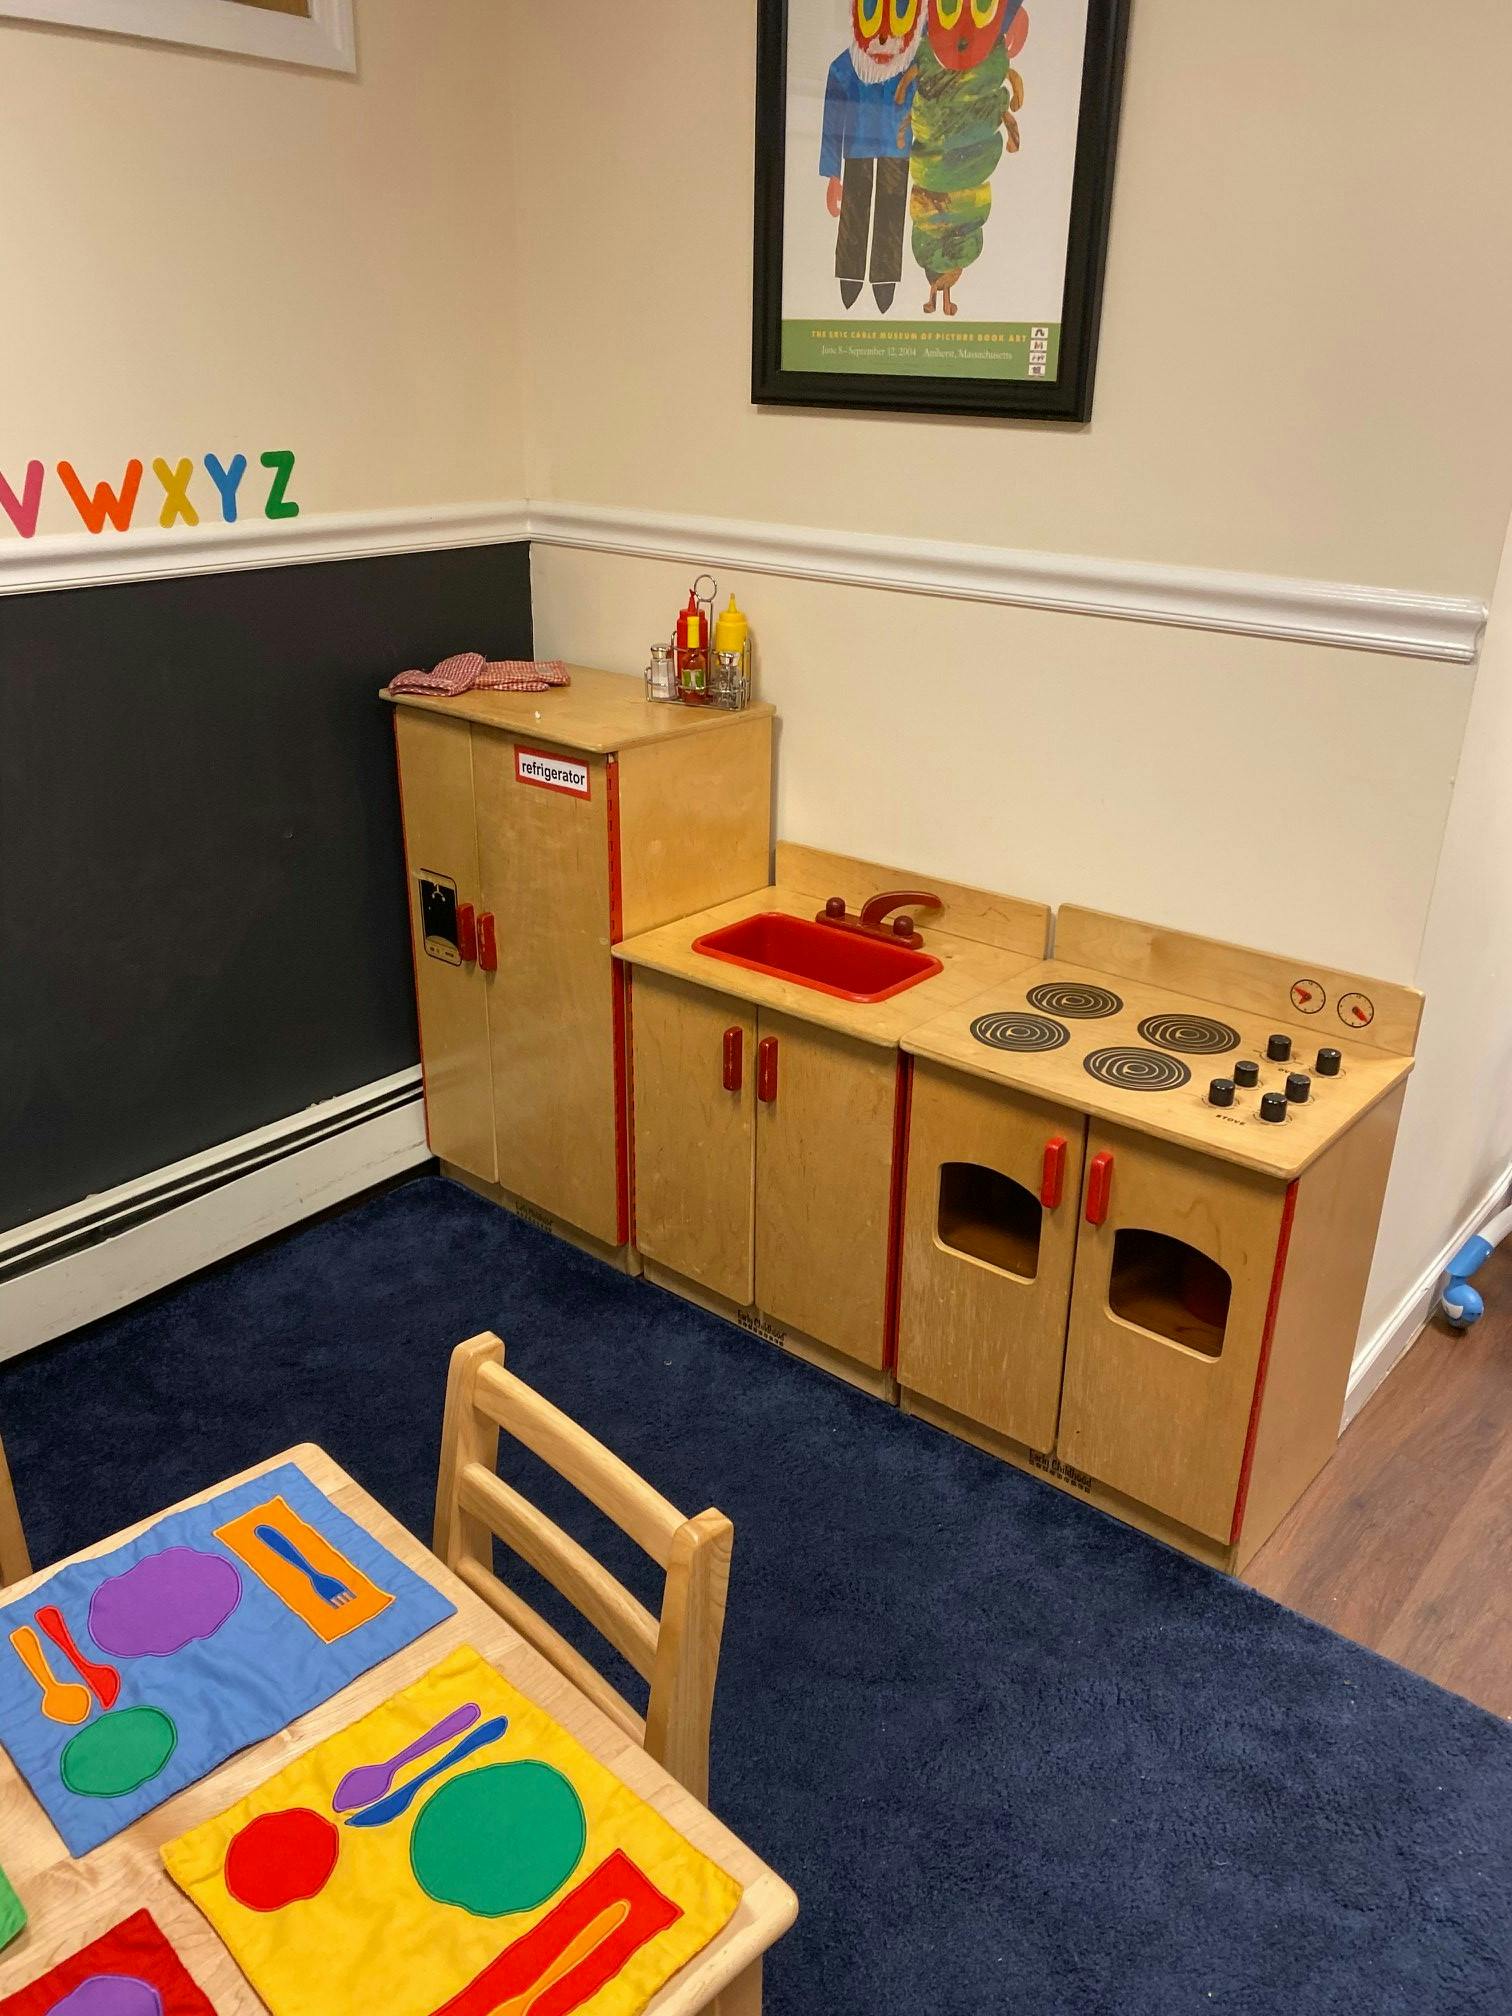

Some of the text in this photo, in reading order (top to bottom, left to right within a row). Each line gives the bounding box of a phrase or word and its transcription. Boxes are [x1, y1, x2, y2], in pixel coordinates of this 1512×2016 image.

[812, 330, 826, 338] THE
[880, 331, 917, 340] MUSEUM
[921, 332, 933, 340] OF
[935, 332, 974, 341] PICTURE
[977, 333, 1004, 342] BOOK
[1008, 334, 1027, 343] ART
[822, 345, 836, 356] June
[959, 348, 1013, 361] Massachusetts
[522, 762, 585, 785] refrigerator
[1216, 1114, 1246, 1126] STOVE
